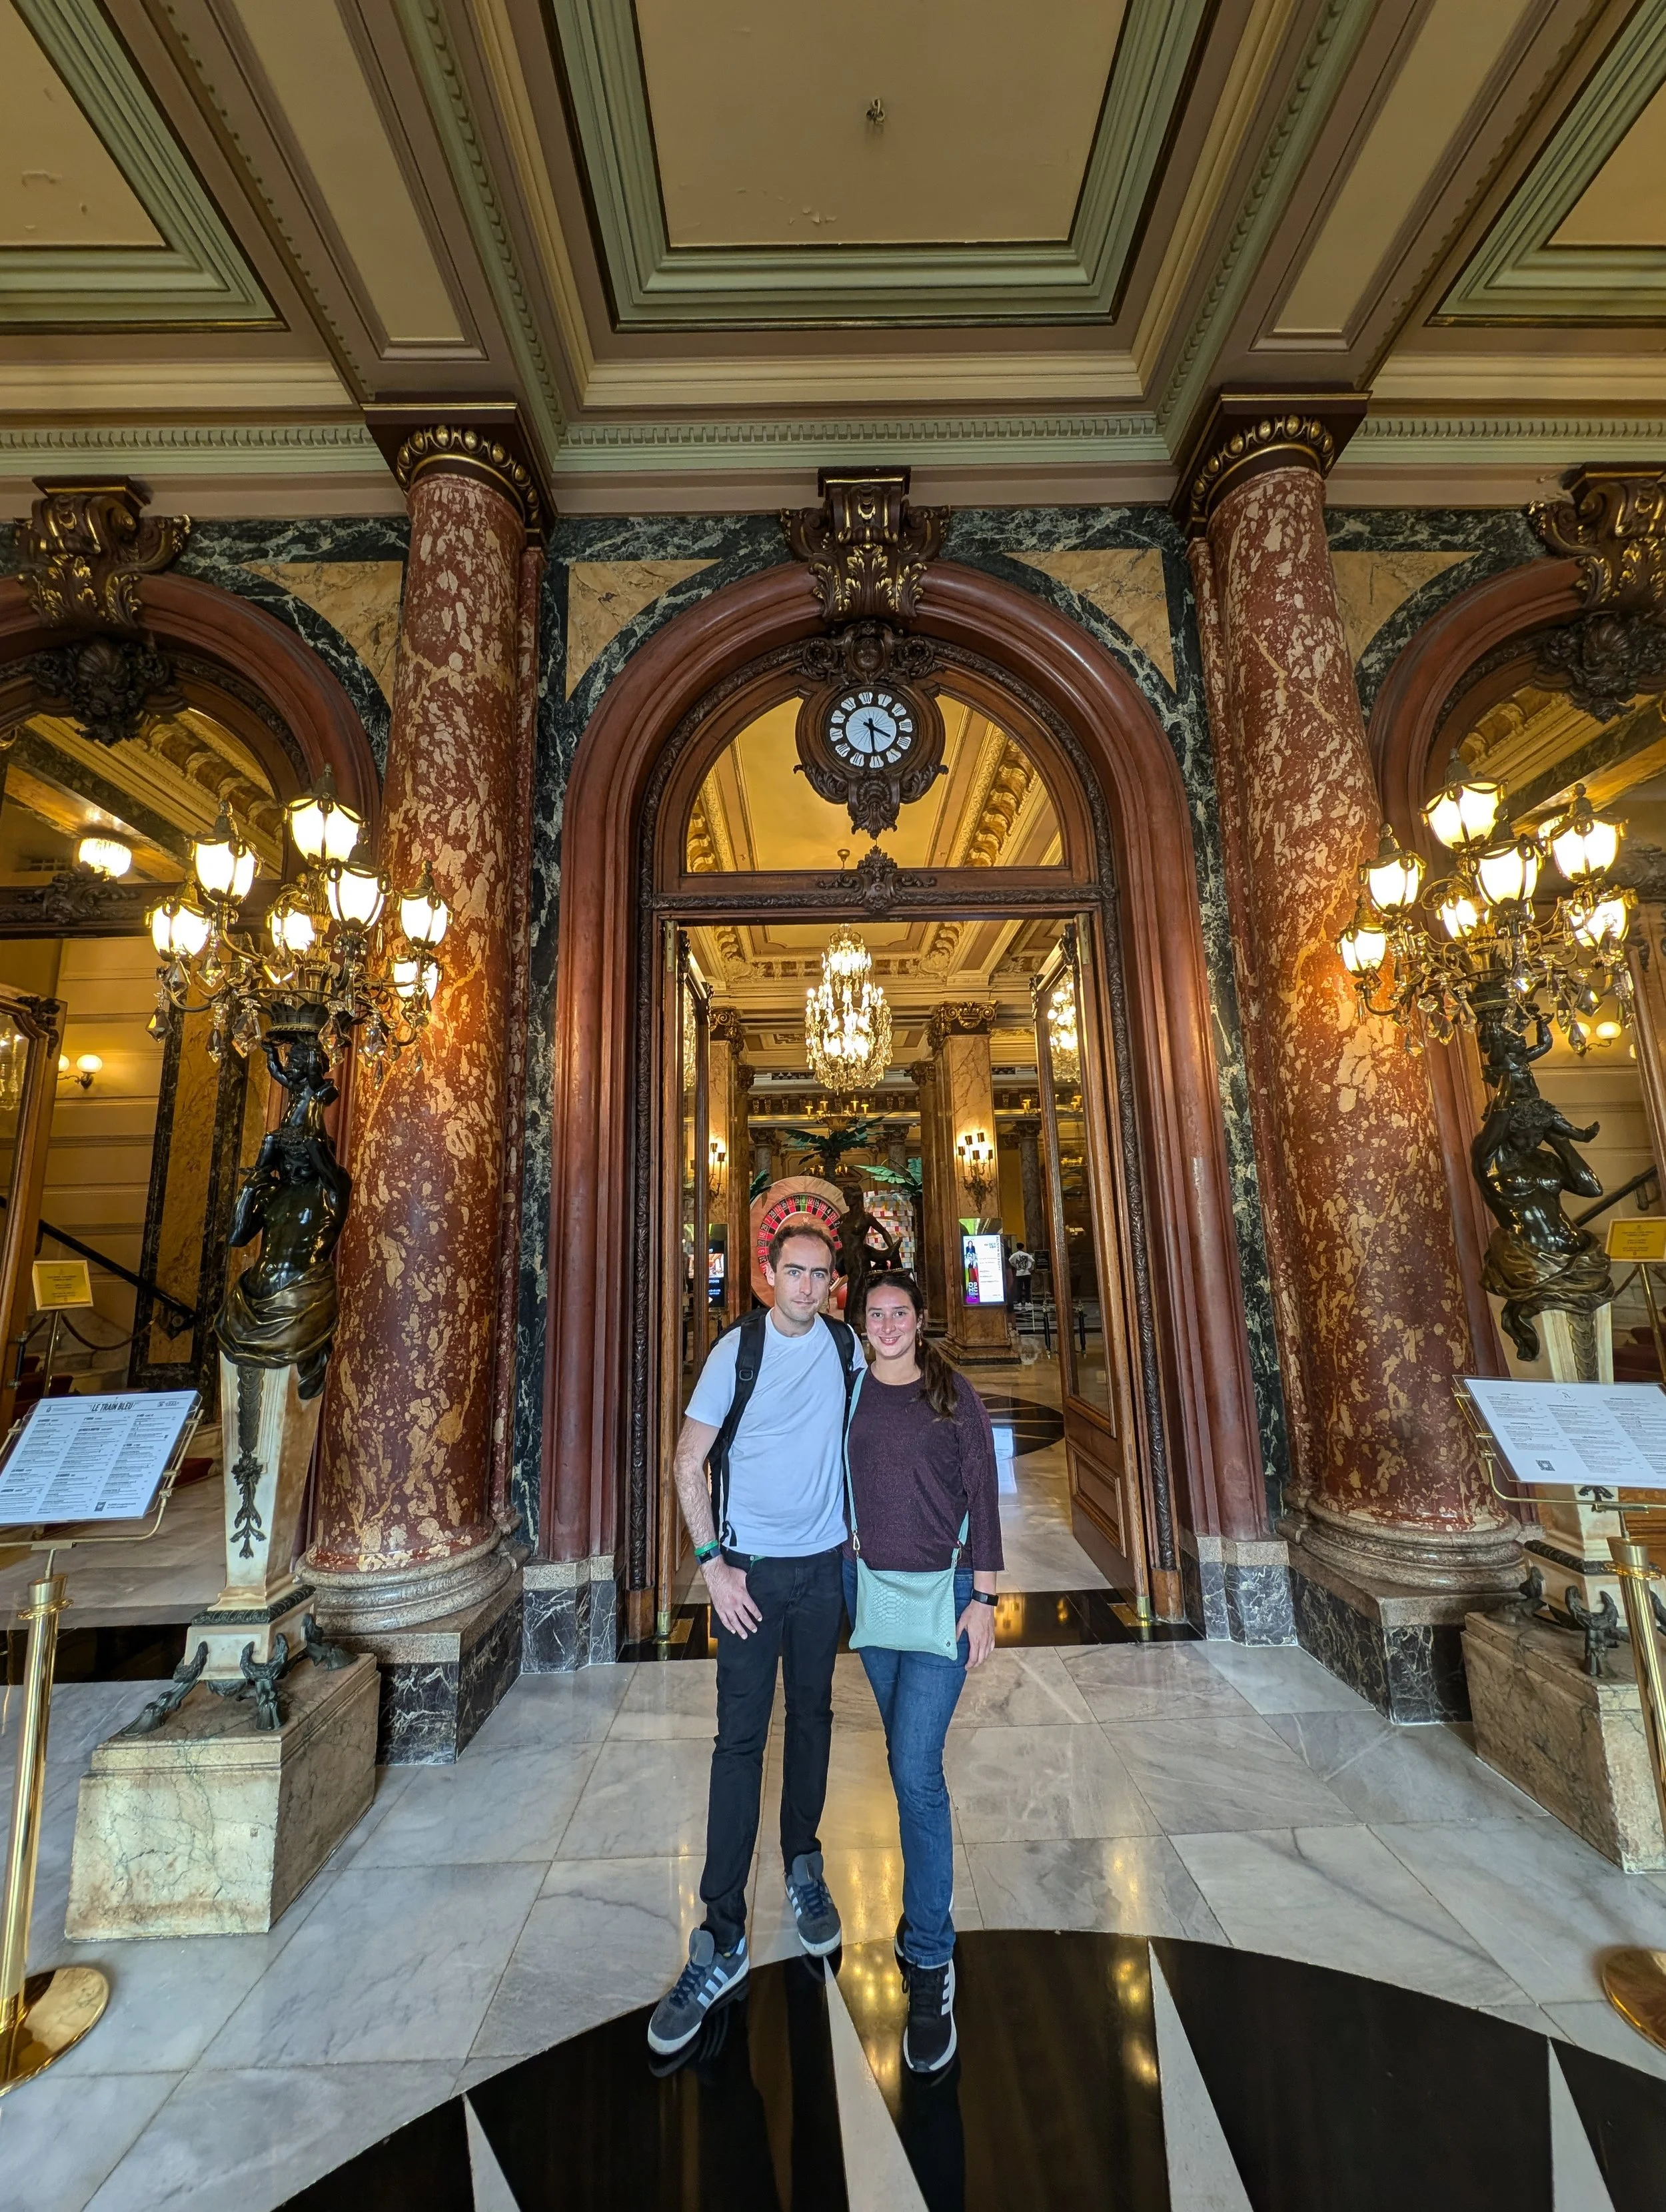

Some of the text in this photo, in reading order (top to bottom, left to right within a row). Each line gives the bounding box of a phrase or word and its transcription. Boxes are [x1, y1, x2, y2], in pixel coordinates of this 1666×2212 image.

[91, 1402, 134, 1412] LE TRAIN BLEU
